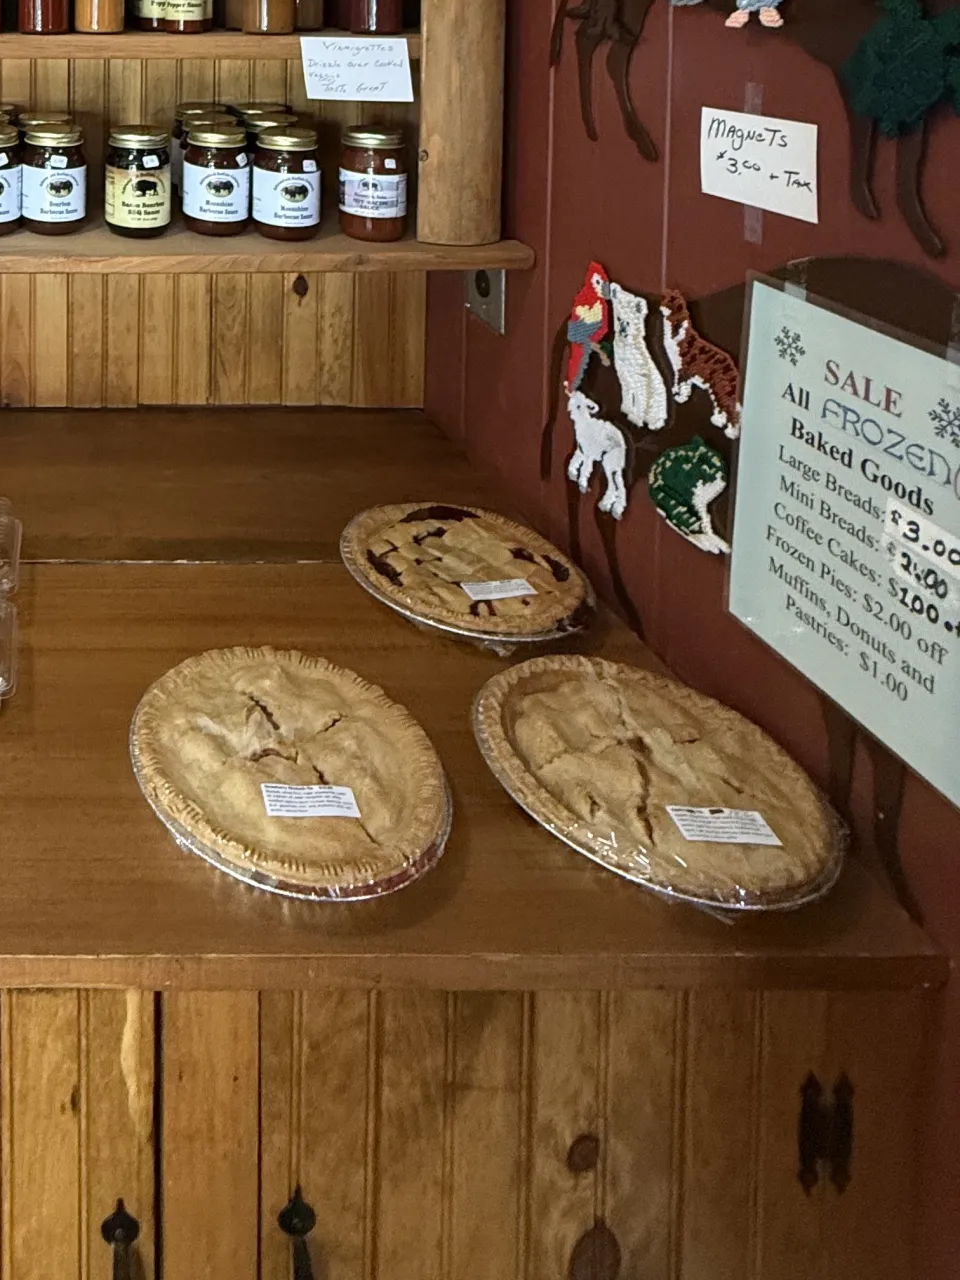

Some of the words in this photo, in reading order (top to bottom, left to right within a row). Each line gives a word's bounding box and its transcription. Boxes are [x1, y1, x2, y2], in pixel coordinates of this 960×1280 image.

[781, 382, 810, 410] All
[820, 398, 952, 485] FROZEN
[824, 359, 903, 418] SALE
[778, 444, 821, 482] Large
[825, 472, 886, 522] Breads:
[779, 475, 815, 510] Mini
[819, 500, 880, 552] Breads:
[790, 416, 853, 469] Baked
[860, 457, 934, 516] Goods
[765, 524, 815, 571] Frozen
[819, 561, 858, 603] Pies:
[863, 593, 912, 641] $2.00
[917, 637, 949, 665] off
[774, 502, 824, 546] Coffee
[827, 537, 883, 587] Cakes:
[768, 555, 832, 617] Muffins,
[836, 605, 896, 664] Donuts
[901, 659, 935, 694] and
[785, 594, 849, 656] Pastries:
[858, 651, 909, 701] $1.00
